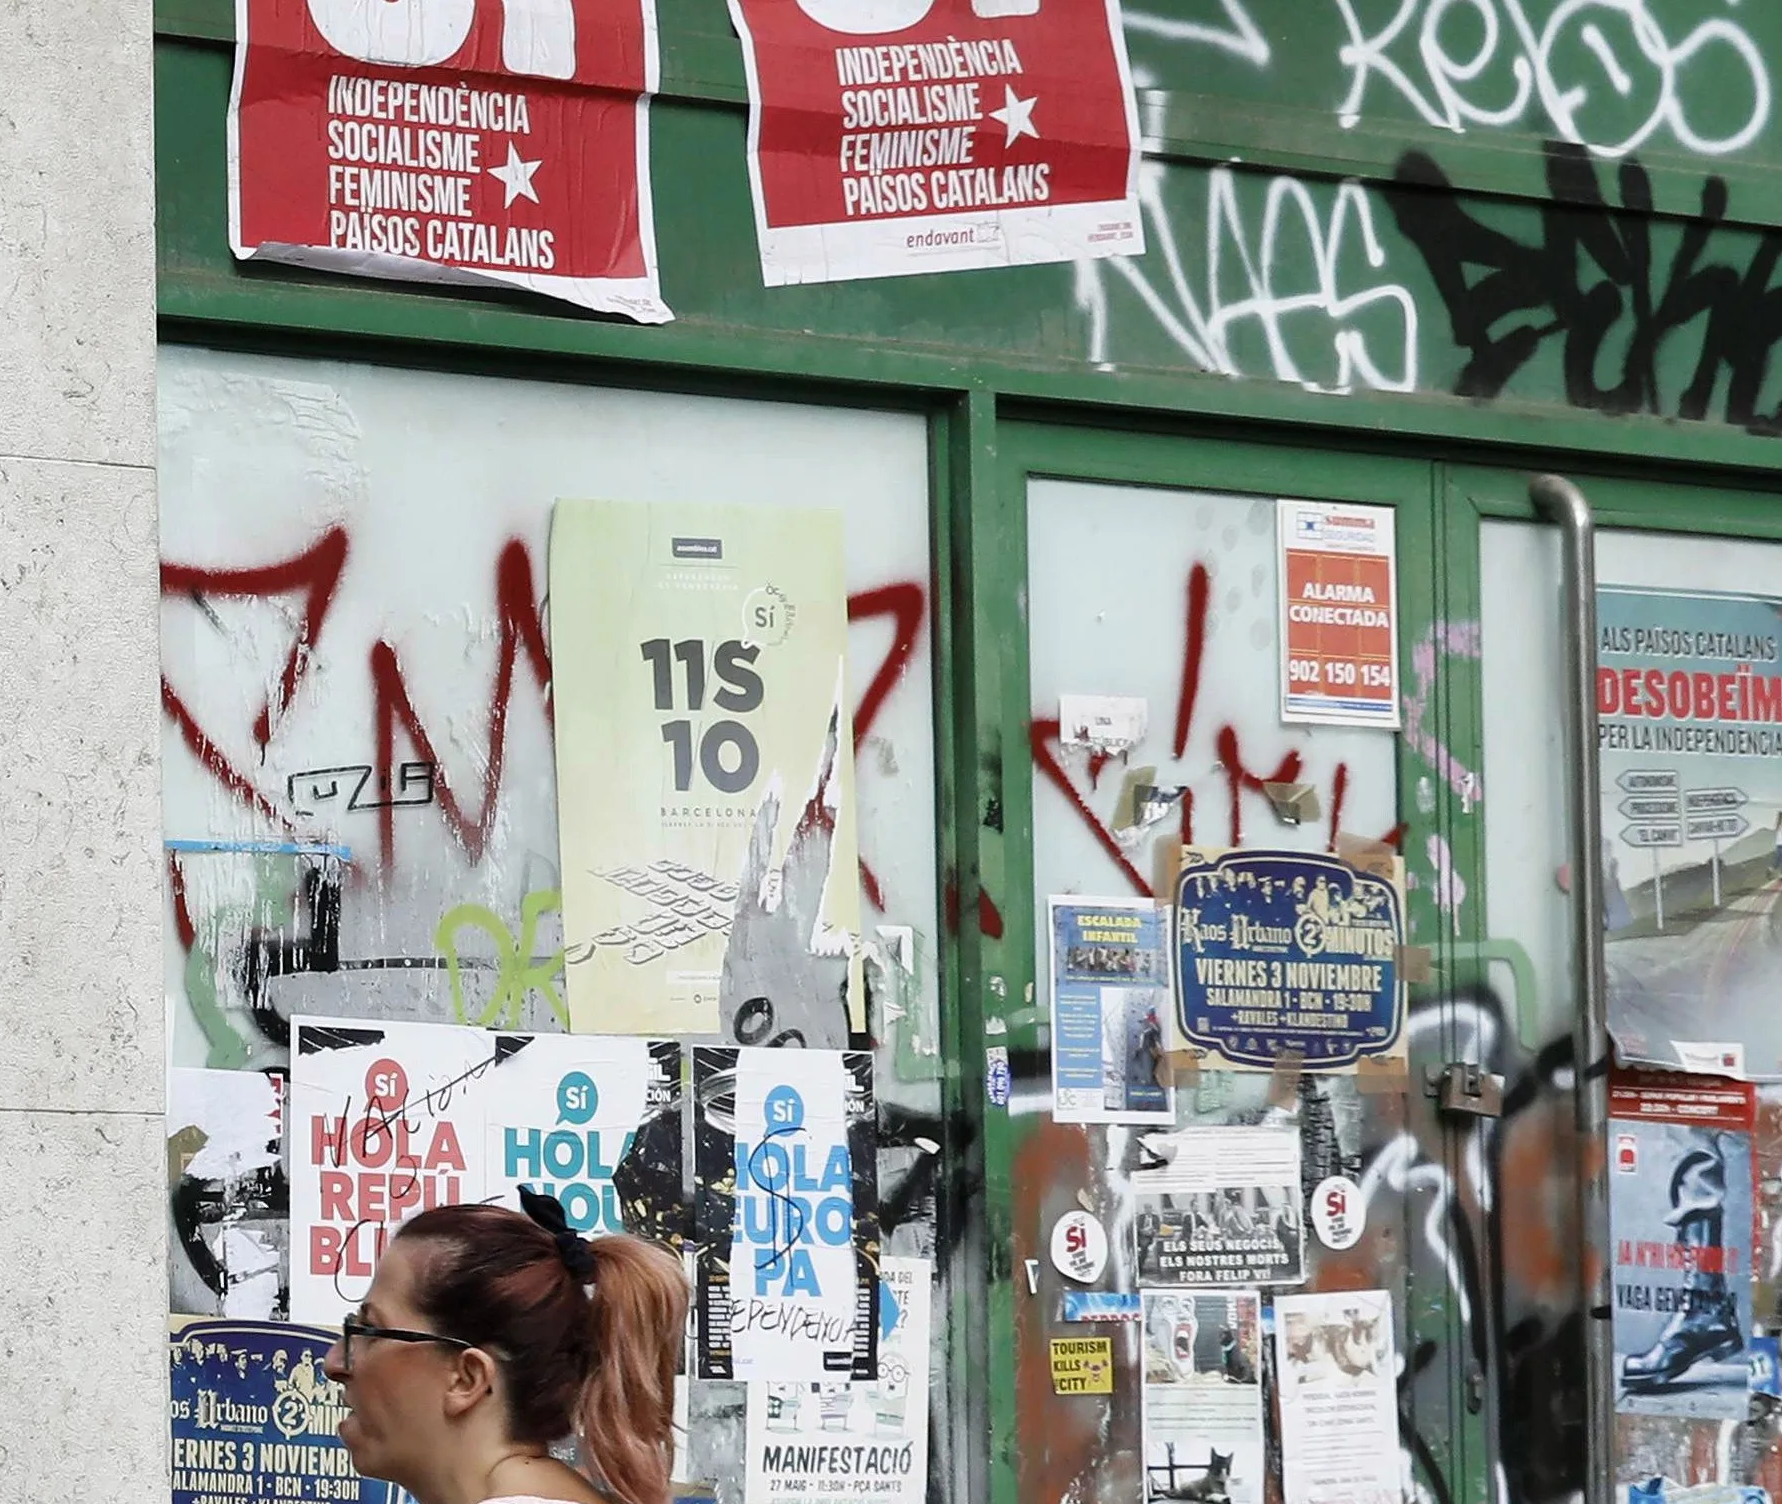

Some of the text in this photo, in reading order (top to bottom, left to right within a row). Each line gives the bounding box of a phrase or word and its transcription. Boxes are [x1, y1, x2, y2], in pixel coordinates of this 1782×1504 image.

[835, 38, 1022, 86] INDEPENDÈNCIA
[328, 75, 531, 136] INDEPENDÈNCIA
[841, 83, 983, 129] SOCIALISME
[327, 120, 481, 174] SOCIALISME
[841, 127, 973, 172] FEMINISME
[328, 165, 472, 217] FEMINISME
[841, 163, 1050, 217] PAÏSOS CATALANS
[329, 205, 555, 270] PAÏSOS CATALANS
[906, 227, 974, 248] endavant
[1303, 582, 1375, 603] ALARMA
[1289, 606, 1389, 628] CONECTADA
[1602, 626, 1776, 662] ALS PAÏSOS CATALANS
[640, 637, 765, 713] 11S
[1290, 660, 1391, 687] 902 150 154
[661, 719, 760, 794] 10
[661, 807, 757, 817] BARCELONA
[1077, 915, 1142, 927] ESCALADA
[1083, 931, 1138, 943] INFANTIL
[1326, 927, 1394, 956] MINUTOS
[1195, 958, 1382, 991] VIERNES 3 NOVIEMBRE
[1207, 988, 1282, 1008] SALAMANDRA
[311, 1115, 466, 1172] HOLA
[1160, 1254, 1242, 1267] ELS NOSTRES
[1163, 1241, 1186, 1252] ELS
[1190, 1240, 1222, 1251] SEUS
[754, 1249, 823, 1297] PA
[1179, 1271, 1212, 1281] FORA
[1216, 1270, 1250, 1281] FELIP
[1053, 1343, 1107, 1354] TOURISM
[1054, 1360, 1080, 1371] KILLS
[1060, 1378, 1086, 1391] CITY
[194, 1388, 268, 1429] Urbano
[174, 1439, 236, 1471] ERNES
[242, 1443, 255, 1471] 3
[763, 1441, 914, 1475] MANIFESTACIÓ
[257, 1475, 263, 1495] 1
[276, 1476, 302, 1497] BCN
[315, 1480, 360, 1500] 19:30H
[770, 1480, 781, 1490] 27
[785, 1480, 806, 1491] MAIG
[874, 1481, 901, 1492] SANTS
